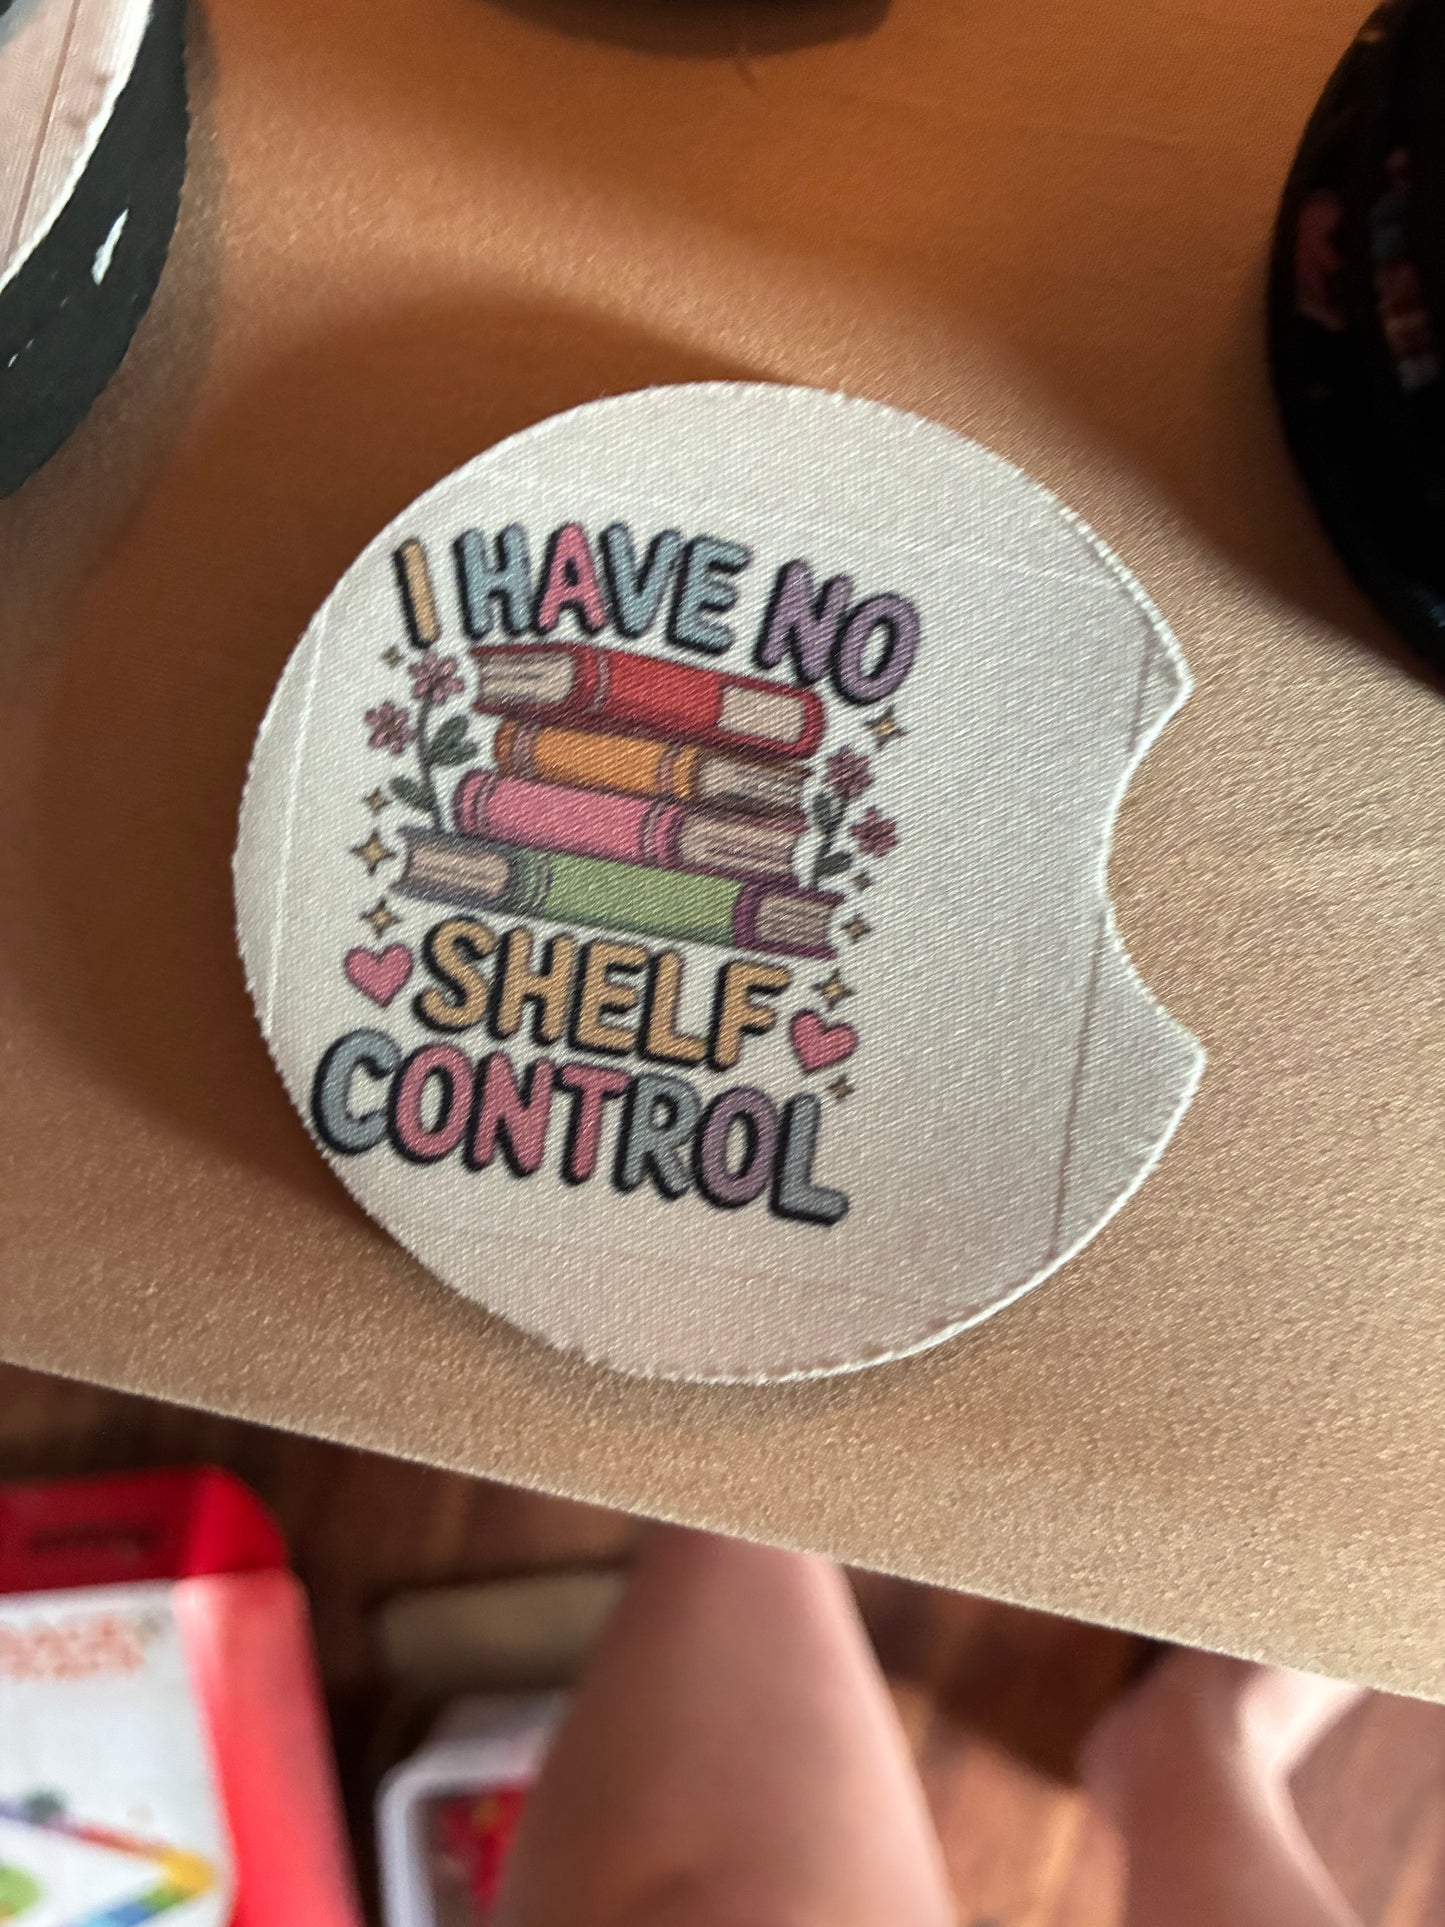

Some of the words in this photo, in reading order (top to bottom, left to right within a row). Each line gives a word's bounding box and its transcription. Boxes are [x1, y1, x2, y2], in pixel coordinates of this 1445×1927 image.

[393, 537, 442, 650] I
[454, 522, 752, 655] HAVE
[756, 558, 922, 704] NO
[412, 916, 793, 1072] SHELF
[311, 1028, 850, 1227] CONTROL
